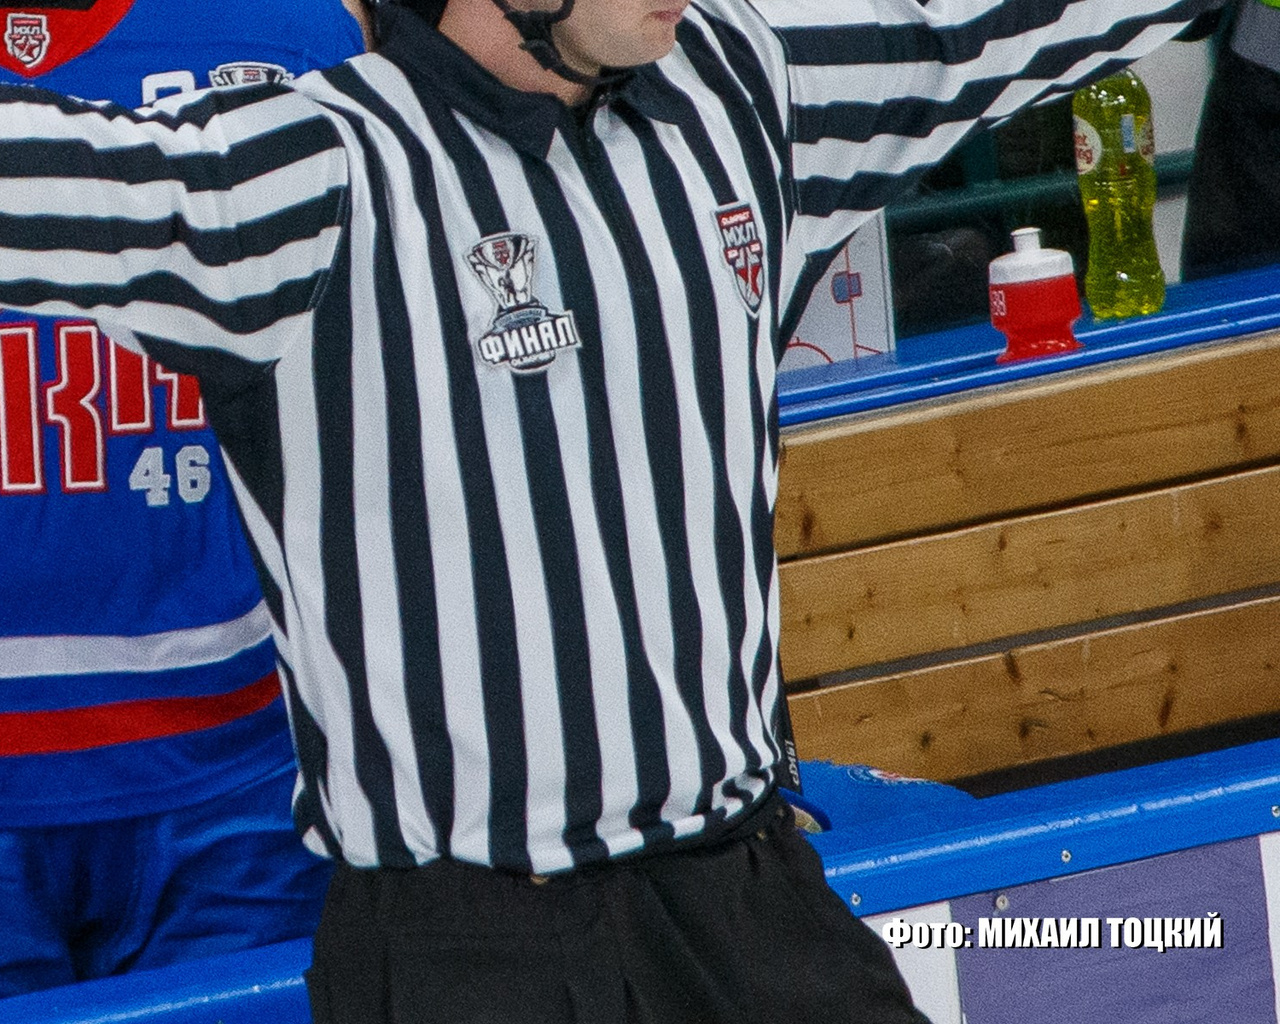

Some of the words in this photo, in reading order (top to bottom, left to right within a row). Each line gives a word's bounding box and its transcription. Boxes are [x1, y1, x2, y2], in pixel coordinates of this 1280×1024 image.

[722, 222, 757, 248] МХЛ
[480, 317, 577, 363] ФИНАЛ
[128, 444, 212, 507] 46
